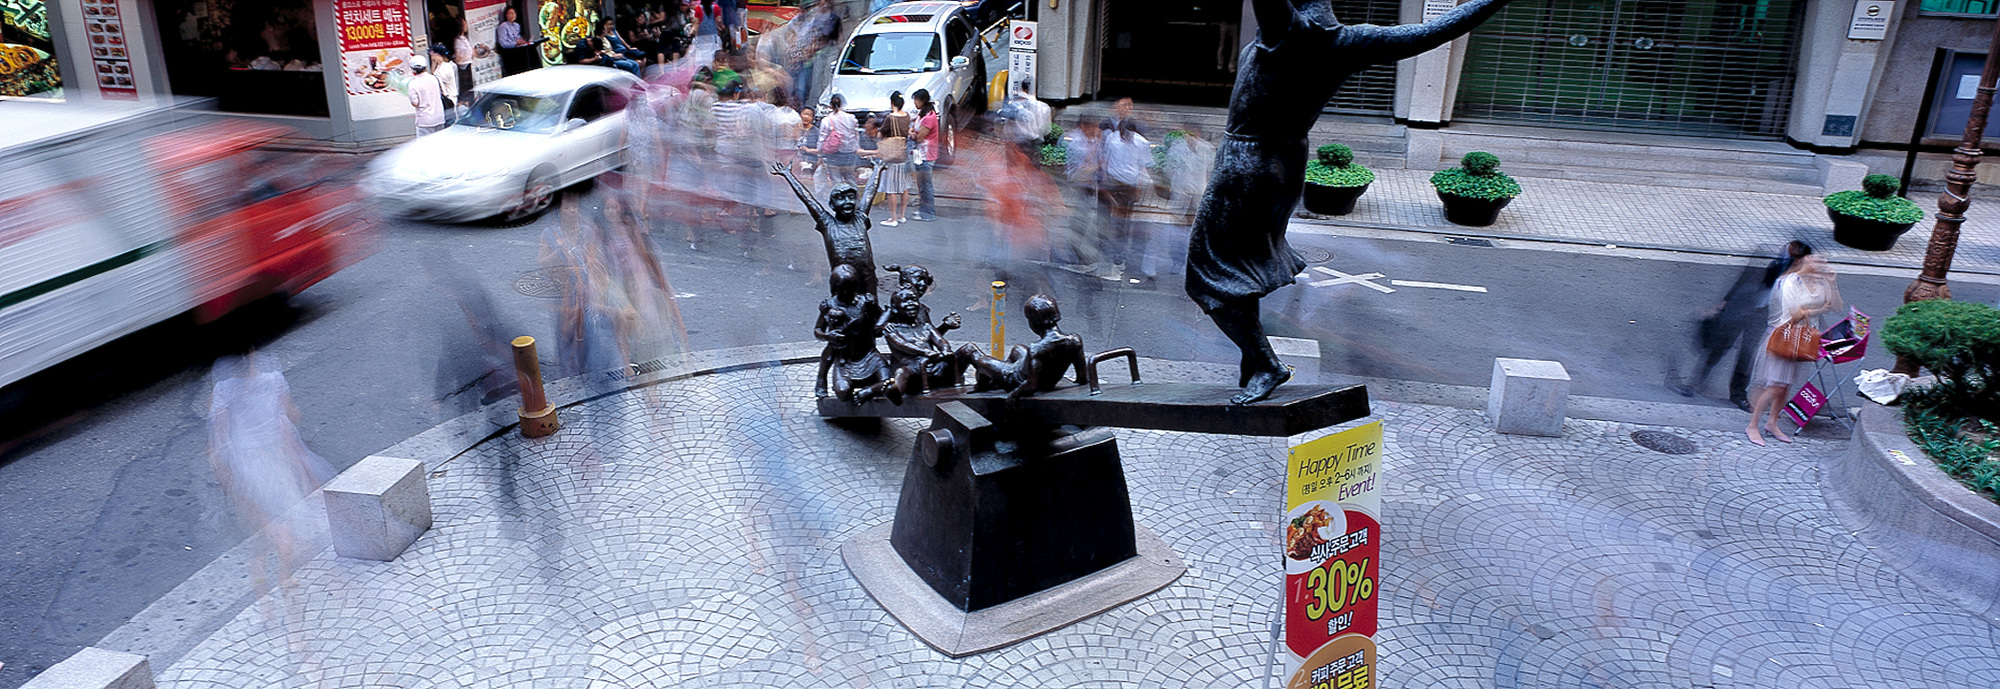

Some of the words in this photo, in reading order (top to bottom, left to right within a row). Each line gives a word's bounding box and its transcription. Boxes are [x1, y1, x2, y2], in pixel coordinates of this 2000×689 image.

[343, 9, 383, 25] 런치세트
[383, 8, 402, 22] 메뉴
[345, 23, 385, 42] 13,000원
[386, 22, 404, 38] 부터
[1298, 453, 1343, 478] Happy
[1346, 442, 1376, 463] Time
[1302, 481, 1317, 495] (평일
[1319, 476, 1333, 489] 오후
[1338, 472, 1376, 501] Event!
[1306, 557, 1373, 620] 30%
[1327, 610, 1353, 636] 할인!
[1294, 668, 1307, 688] 2.
